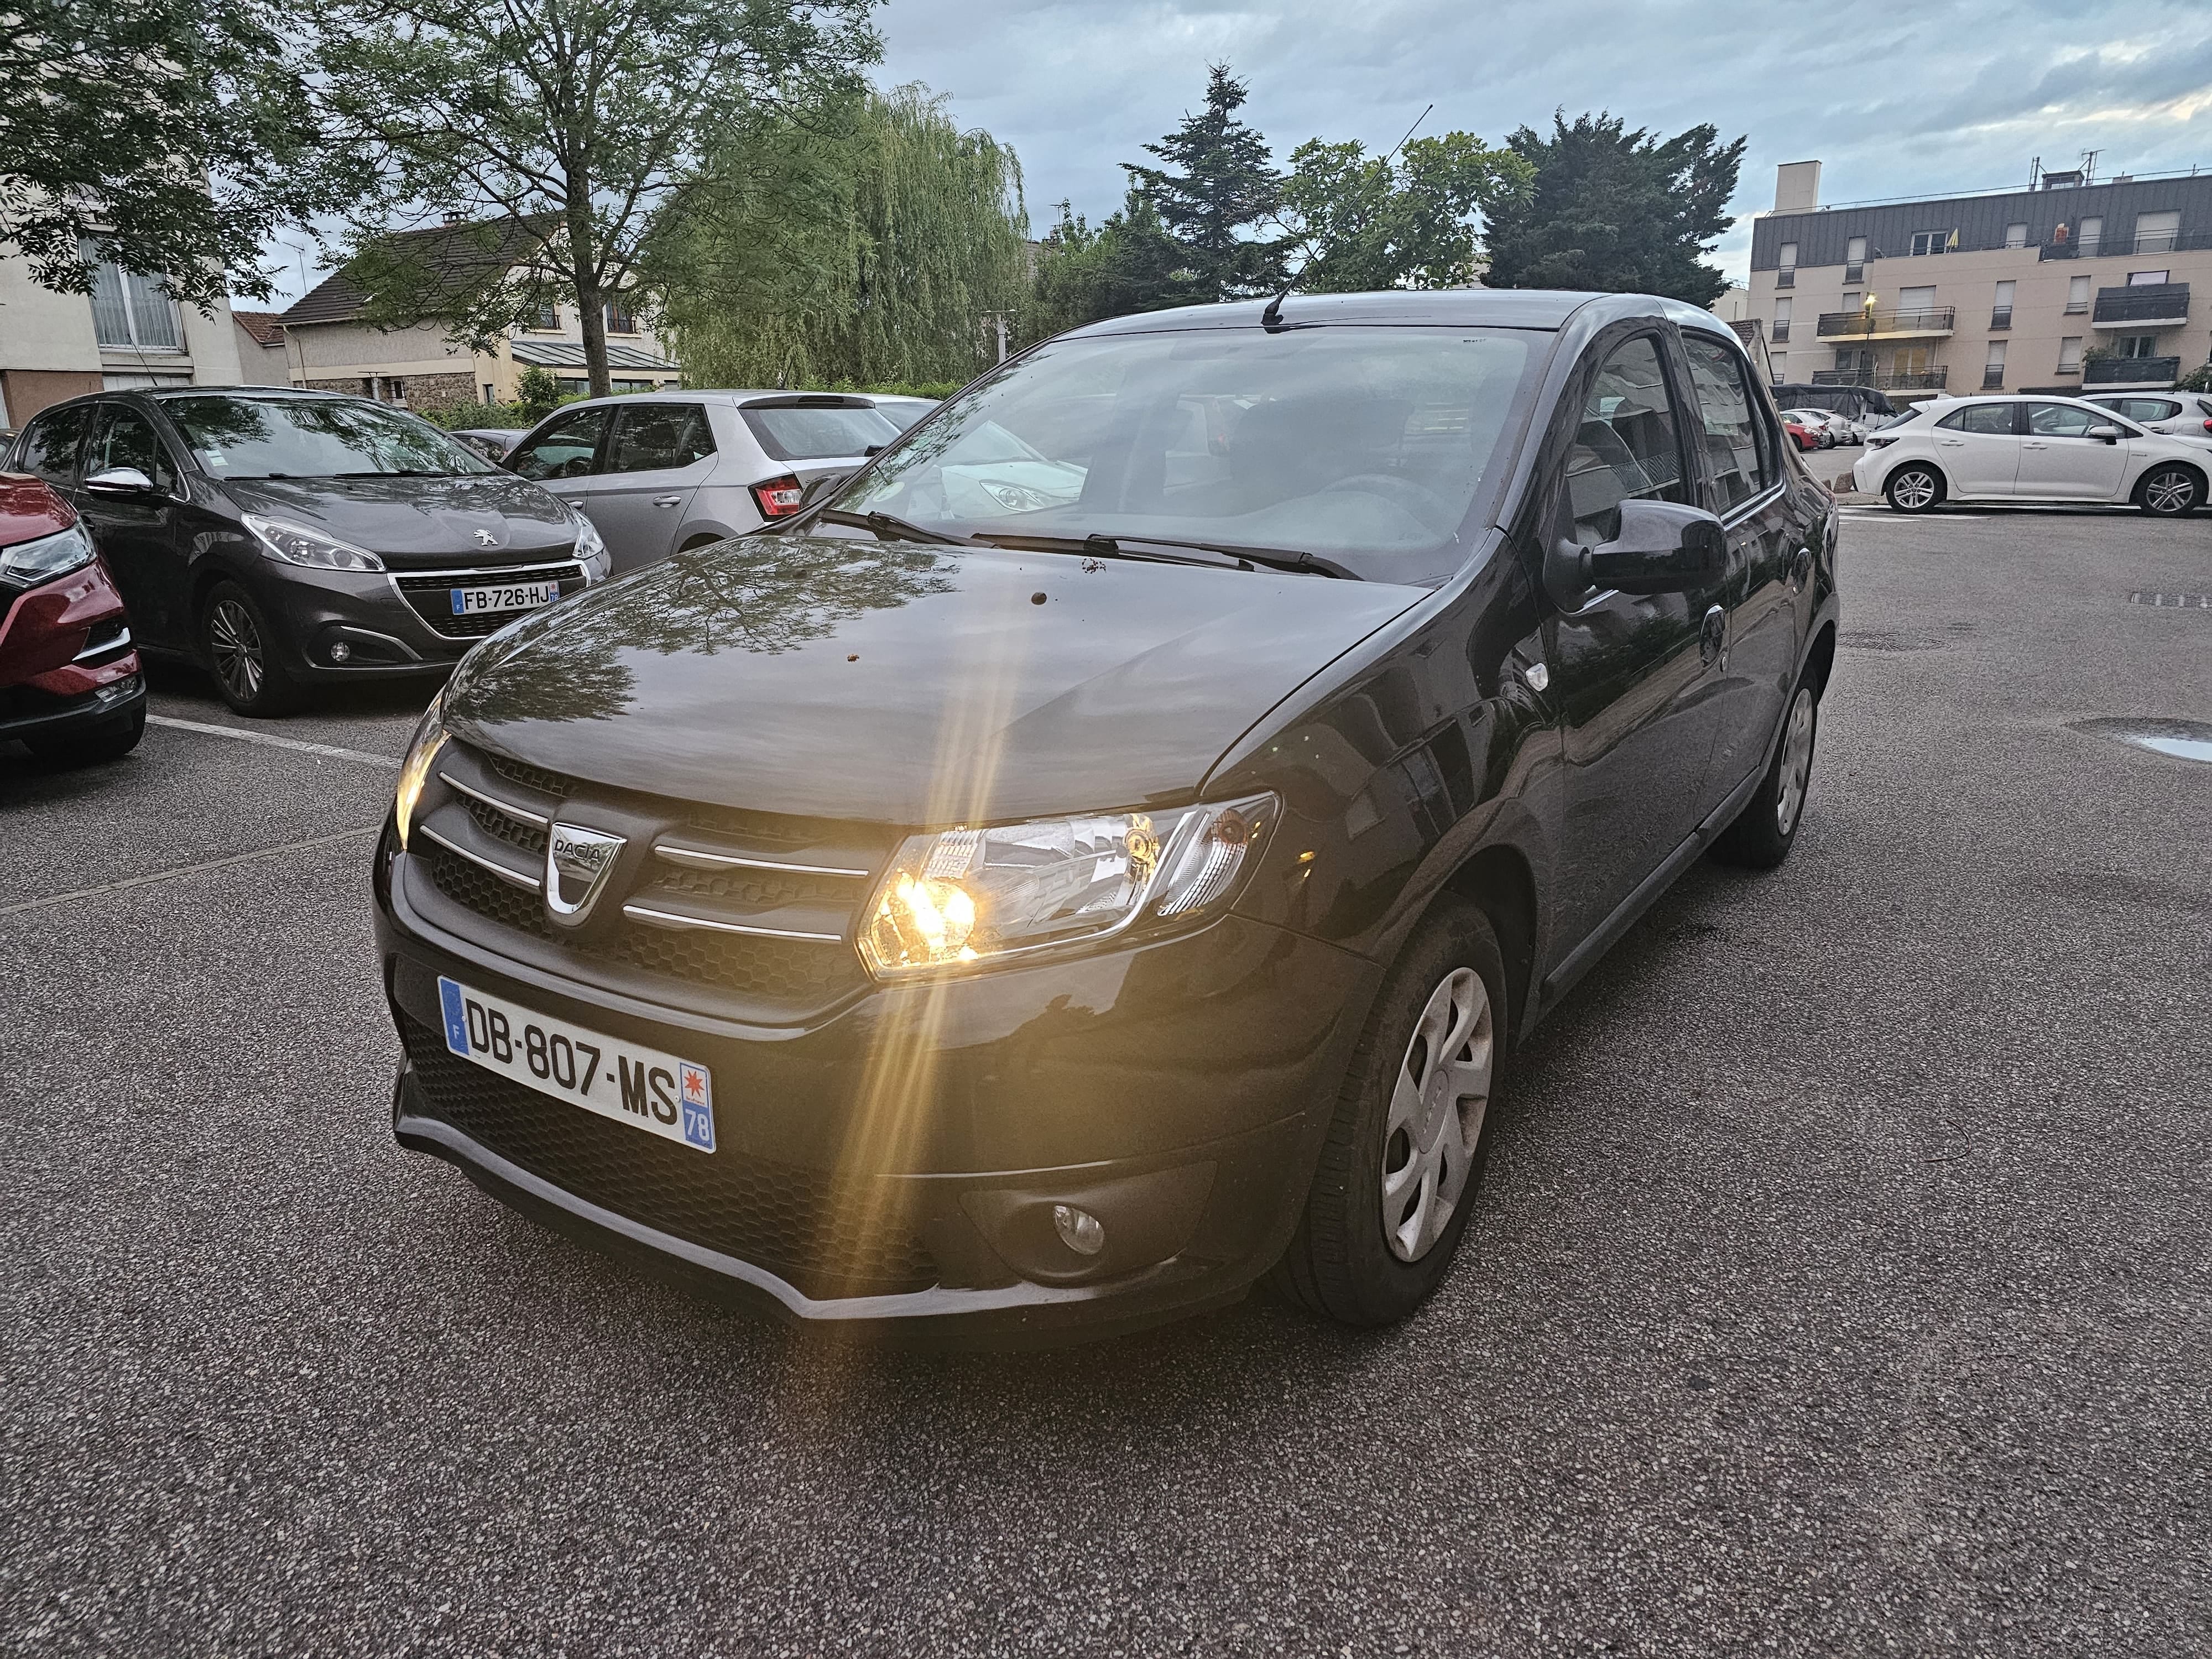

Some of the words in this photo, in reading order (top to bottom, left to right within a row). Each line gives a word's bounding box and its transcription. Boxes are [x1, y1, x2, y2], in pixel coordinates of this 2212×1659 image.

[464, 586, 549, 609] FB-726-HJ
[554, 839, 601, 860] DACIA
[453, 1024, 460, 1040] F
[466, 998, 677, 1126] DB-807-MS
[685, 1108, 710, 1141] 78
